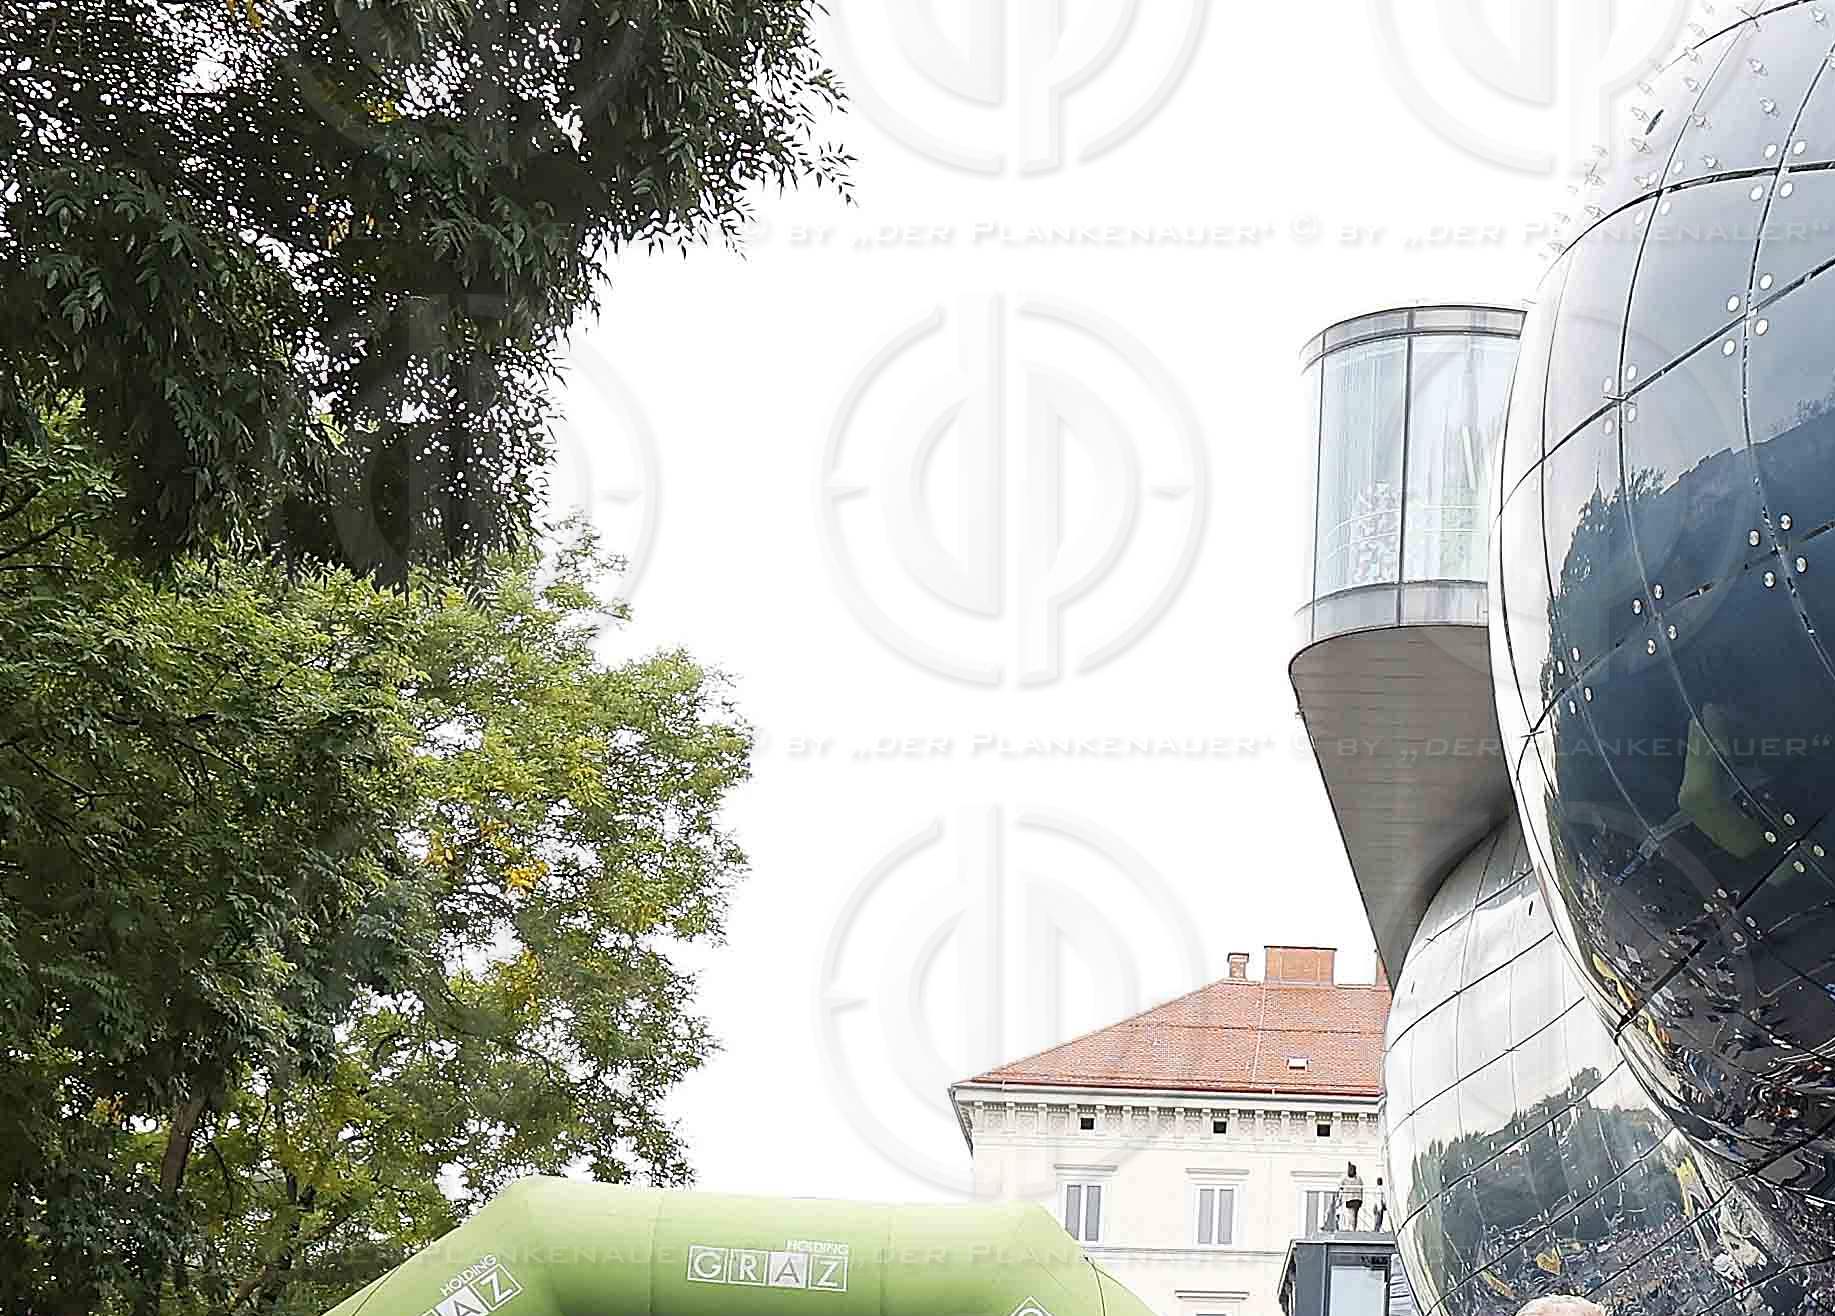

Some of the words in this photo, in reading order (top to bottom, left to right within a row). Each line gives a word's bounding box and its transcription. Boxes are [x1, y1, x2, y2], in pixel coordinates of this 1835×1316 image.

[787, 1240, 848, 1255] HOLDING
[440, 1255, 497, 1297] HOLDING
[693, 1251, 840, 1288] GRAZ
